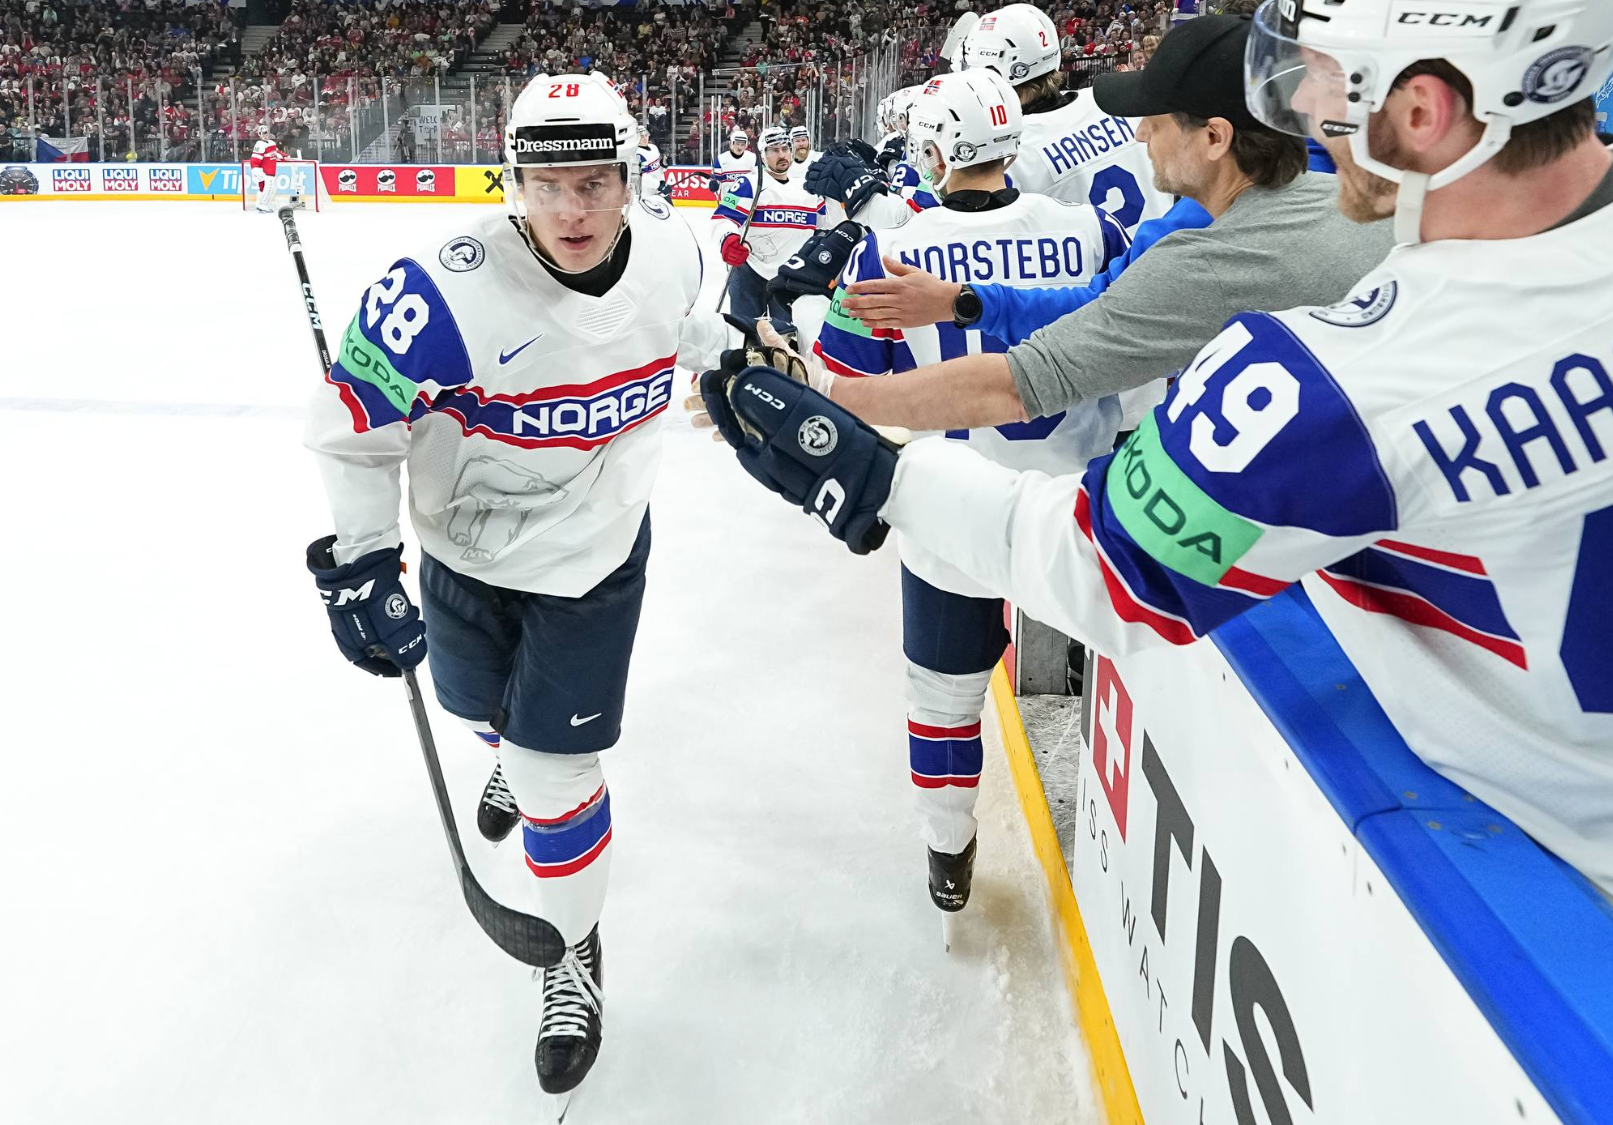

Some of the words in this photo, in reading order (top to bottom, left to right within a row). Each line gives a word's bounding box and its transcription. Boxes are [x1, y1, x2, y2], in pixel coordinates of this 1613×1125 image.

[1397, 11, 1493, 28] CCM
[1038, 31, 1048, 47] 2
[548, 84, 580, 98] 28
[990, 104, 1007, 126] 10
[918, 121, 935, 129] CCM
[1323, 124, 1357, 133] CCM
[516, 138, 614, 153] Dressmann
[1042, 115, 1135, 174] HANSEN
[54, 169, 89, 180] LIQUI
[103, 169, 137, 180] LIQUI
[150, 169, 181, 180] LIQUI
[54, 181, 91, 191] MOLY
[104, 181, 138, 191] MOLY
[151, 181, 182, 191] MOLY
[1089, 164, 1146, 229] 2
[763, 211, 808, 224] NORGE
[900, 236, 1083, 283] NORSTEBO
[302, 283, 324, 330] CCM
[366, 267, 430, 355] 28
[513, 373, 673, 435] NORGE
[744, 383, 786, 411] CCM
[1167, 321, 1301, 473] 49
[1412, 353, 1613, 502] KAA
[1082, 778, 1109, 874] ISS
